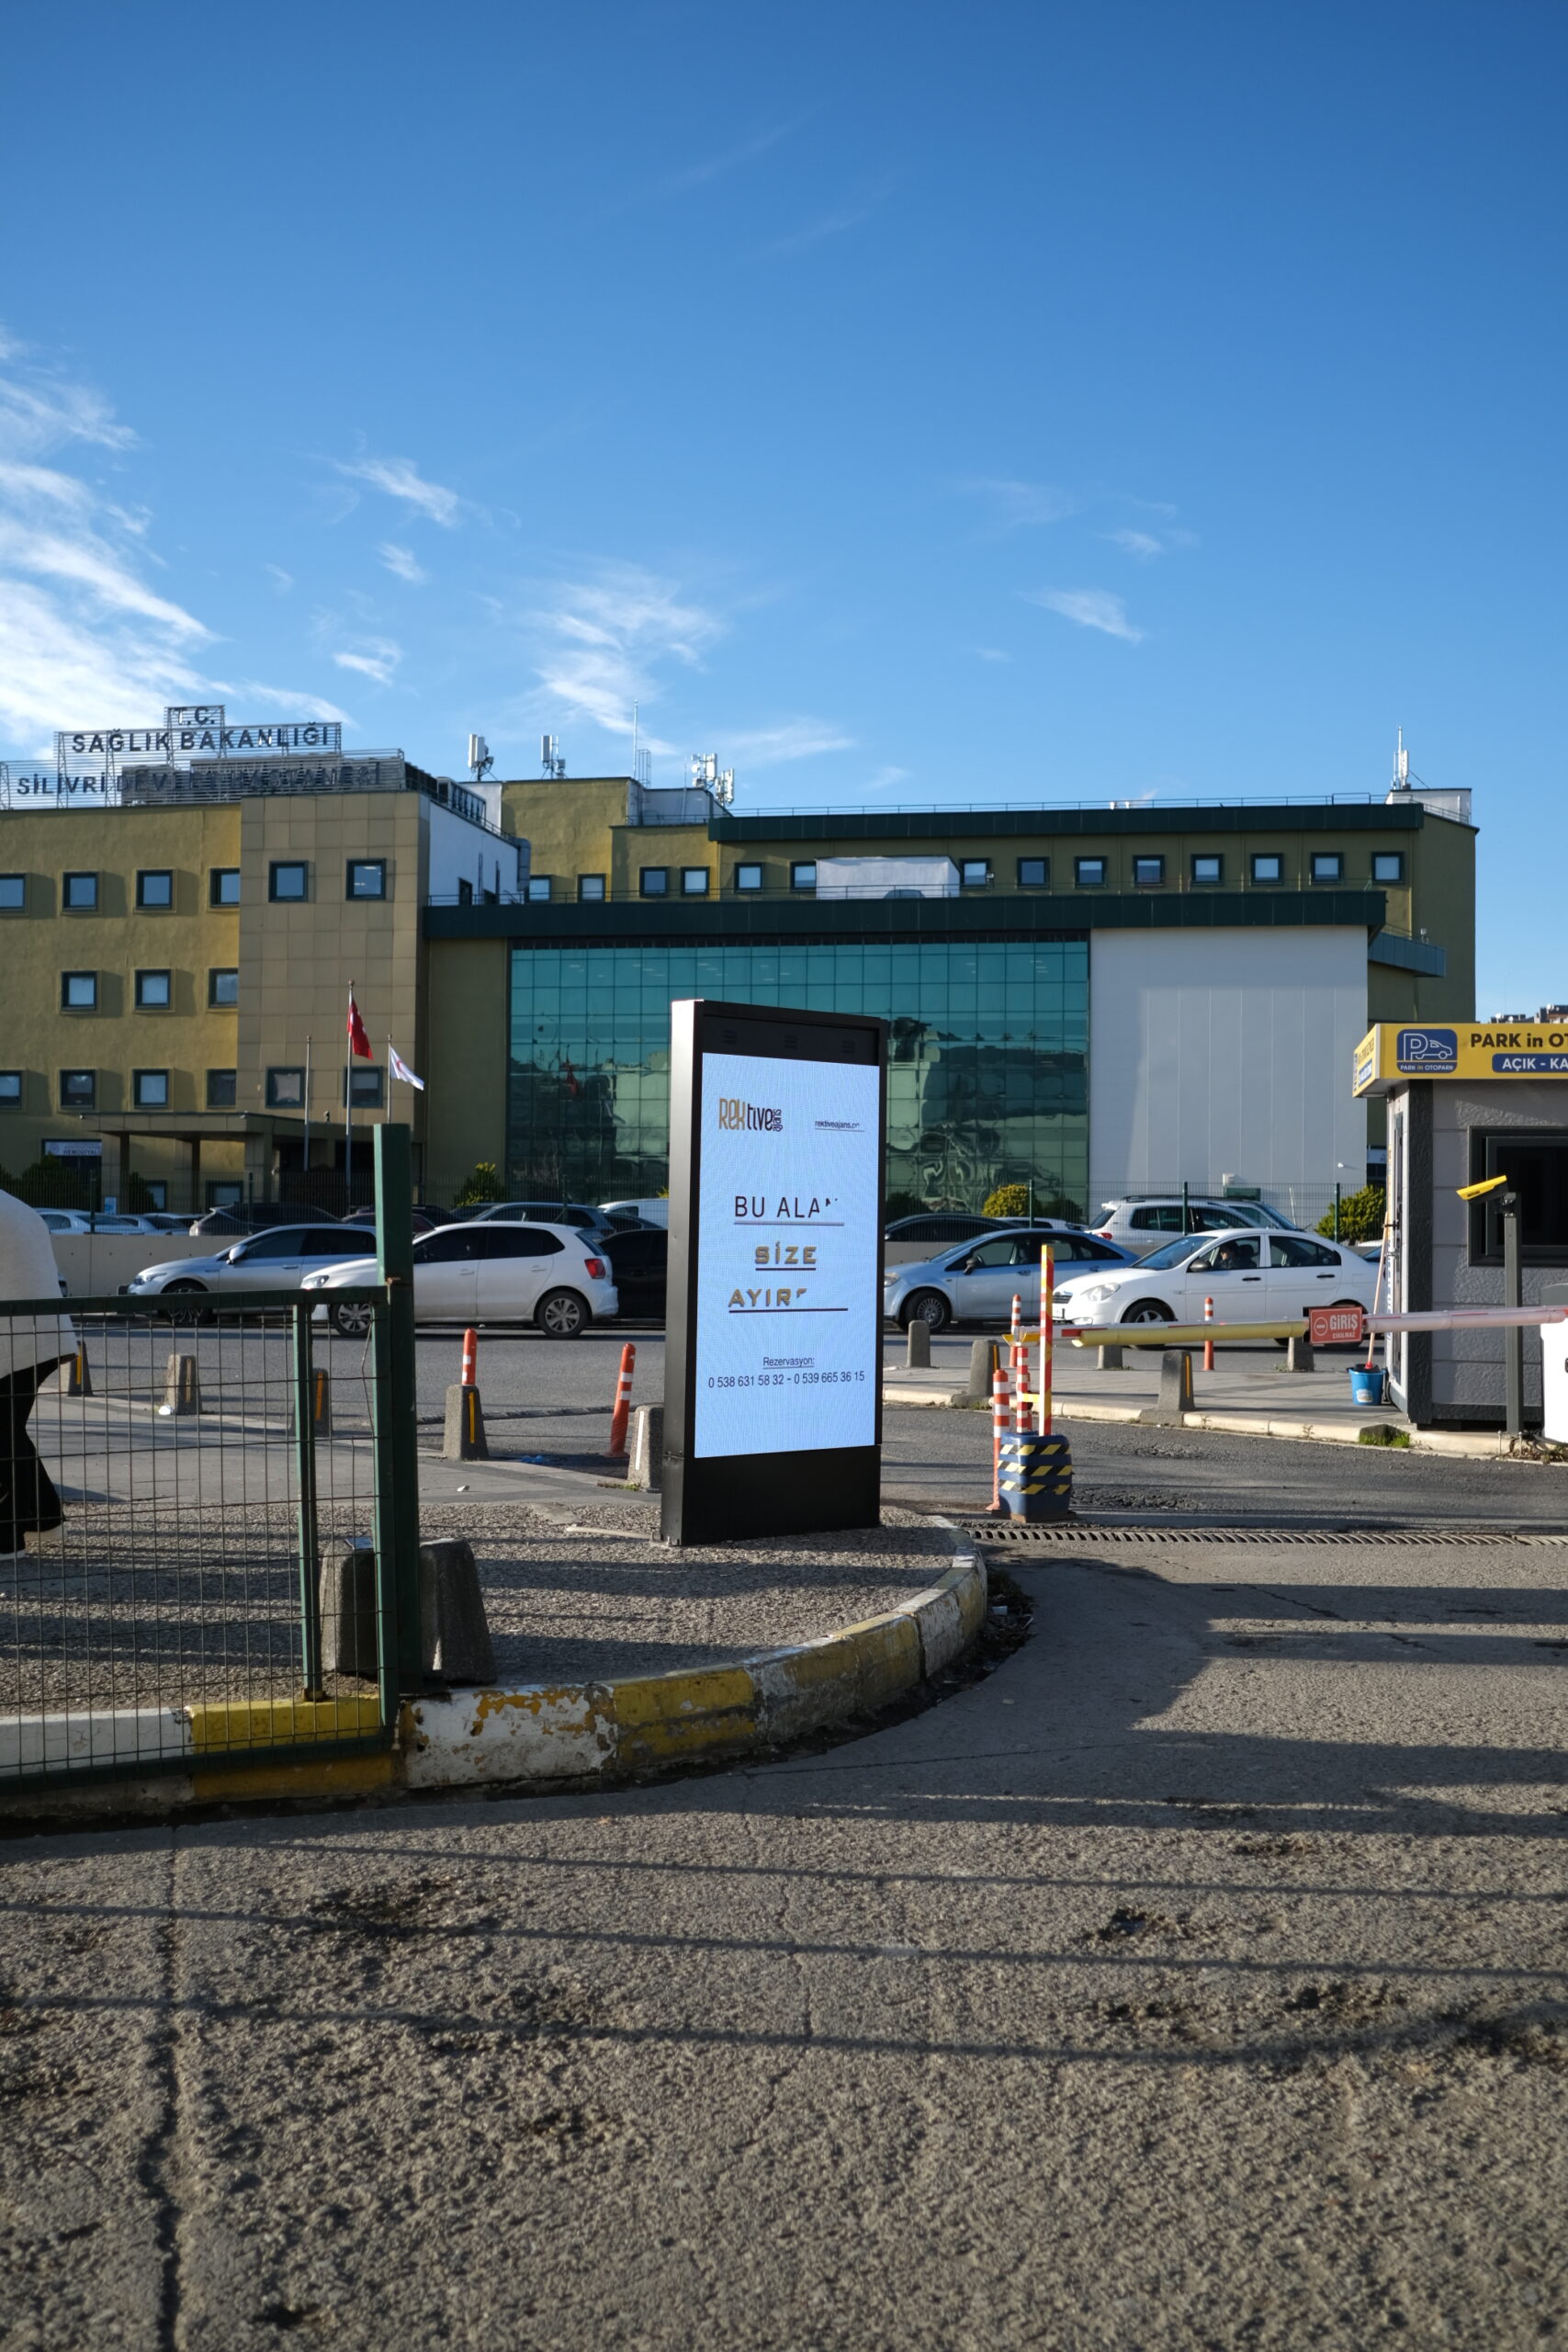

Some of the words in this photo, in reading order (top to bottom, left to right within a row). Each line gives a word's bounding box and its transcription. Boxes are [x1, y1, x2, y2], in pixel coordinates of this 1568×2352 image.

[73, 729, 171, 752] SAĞLIK
[181, 722, 328, 750] BAKANLIĞI
[17, 773, 106, 795] SİLİVRİ
[1471, 1033, 1521, 1048] PARK
[1527, 1033, 1543, 1048] in
[1502, 1057, 1536, 1071] AÇIK
[735, 1196, 765, 1218] BU
[755, 1240, 817, 1265] SİZE
[763, 1356, 815, 1367] Rezervasyon:
[708, 1376, 715, 1388] 0
[717, 1376, 736, 1387] 538
[738, 1375, 754, 1386] 631
[758, 1374, 770, 1386] 58
[773, 1374, 784, 1385] 32
[794, 1374, 800, 1385] 0
[802, 1373, 819, 1384] 539
[821, 1372, 839, 1383] 665
[840, 1371, 852, 1382] 36
[854, 1370, 865, 1382] 15
